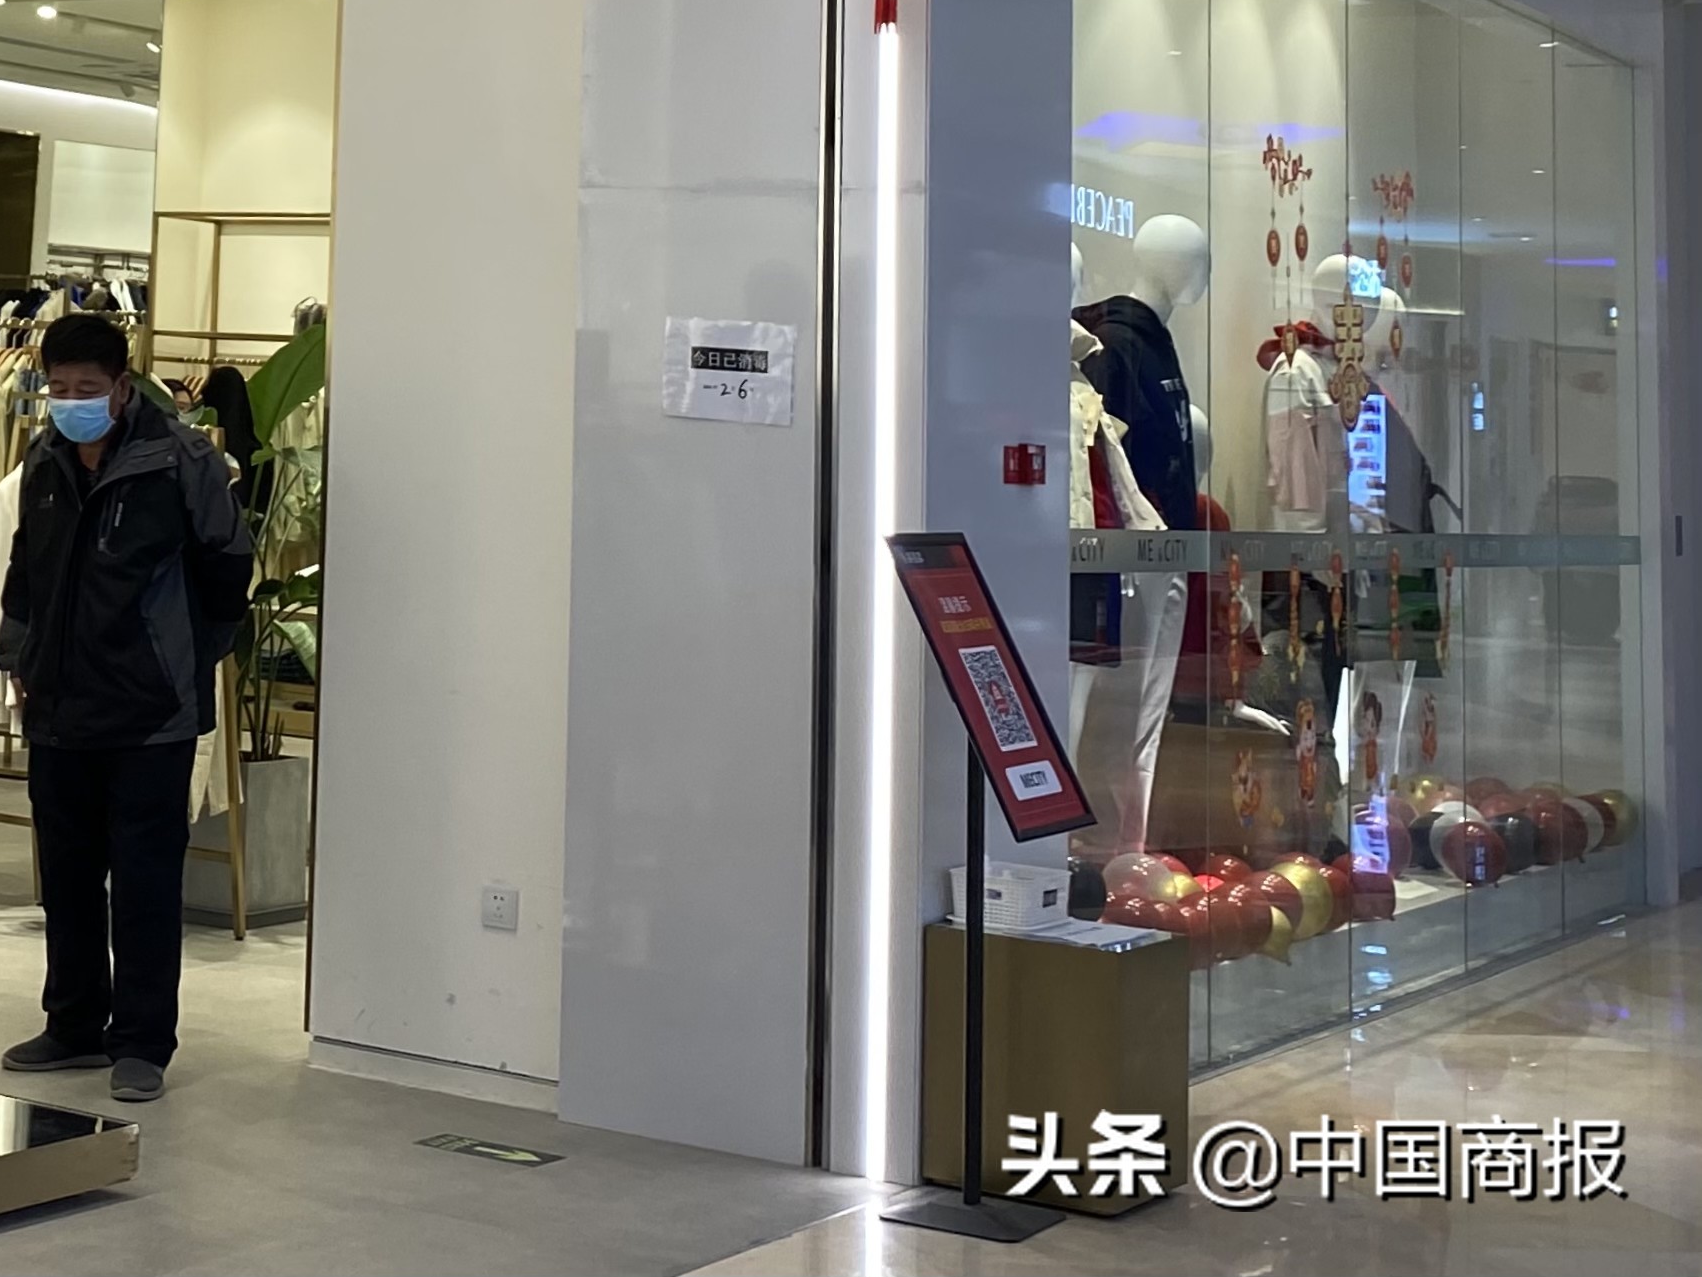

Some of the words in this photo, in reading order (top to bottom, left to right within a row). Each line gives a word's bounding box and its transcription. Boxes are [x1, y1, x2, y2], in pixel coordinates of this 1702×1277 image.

[693, 350, 767, 371] 今日已消毒
